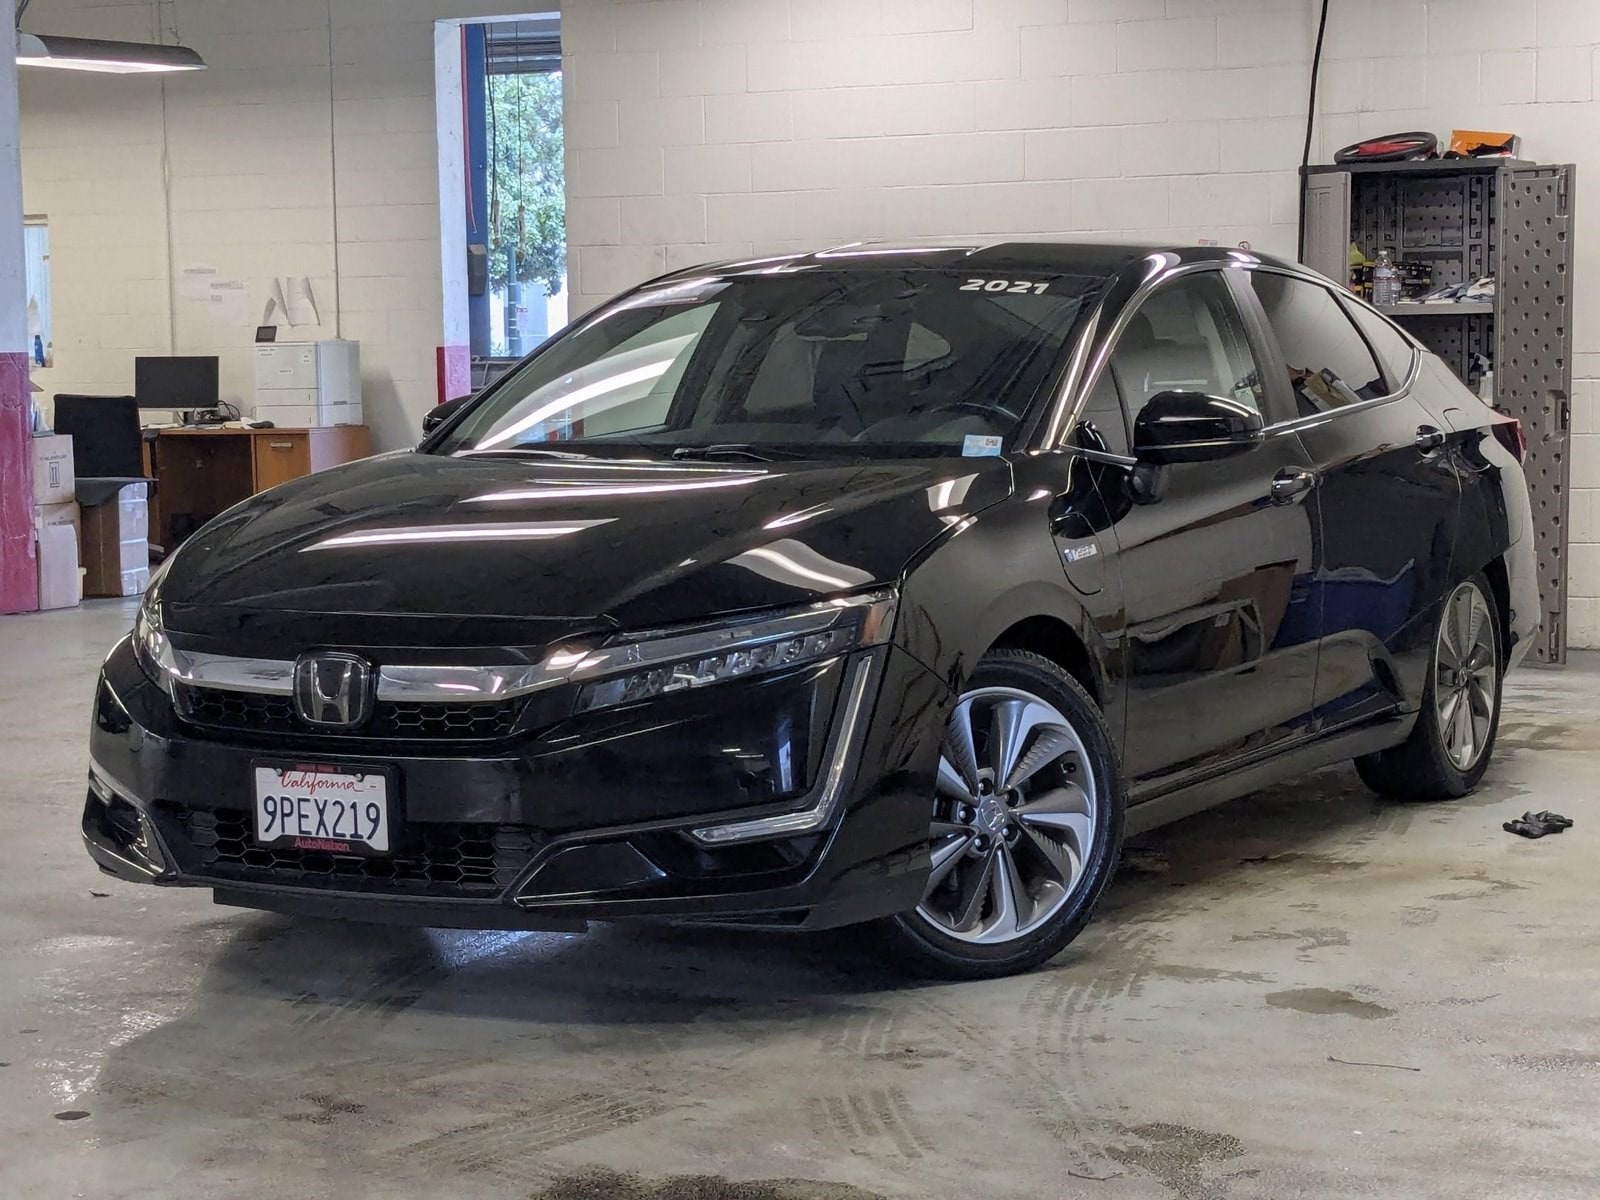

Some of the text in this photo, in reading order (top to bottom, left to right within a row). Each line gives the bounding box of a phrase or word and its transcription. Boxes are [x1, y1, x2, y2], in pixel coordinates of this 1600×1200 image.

[959, 279, 1049, 295] 2021
[281, 771, 364, 794] California
[263, 795, 381, 841] 9PEX219
